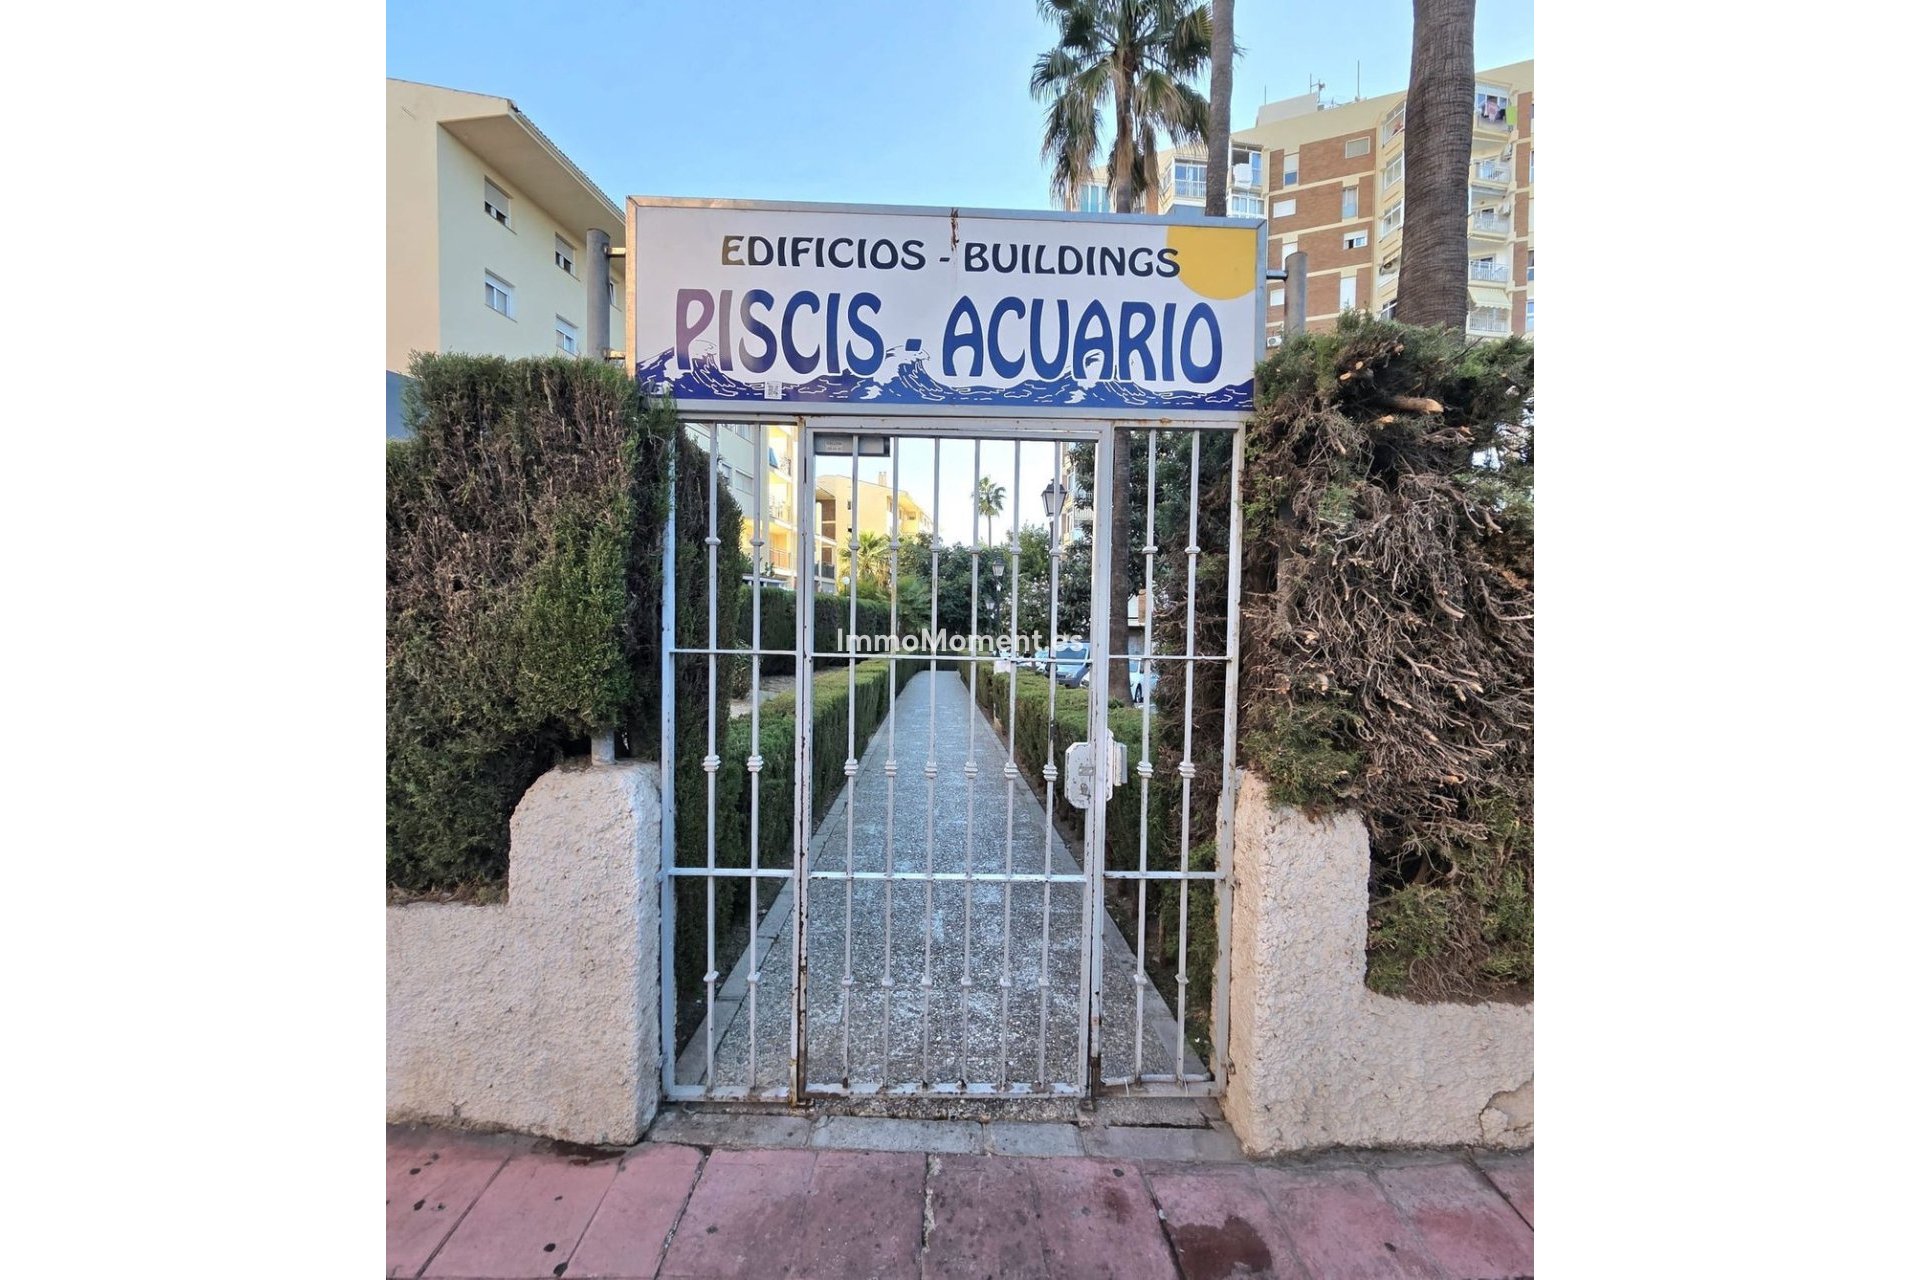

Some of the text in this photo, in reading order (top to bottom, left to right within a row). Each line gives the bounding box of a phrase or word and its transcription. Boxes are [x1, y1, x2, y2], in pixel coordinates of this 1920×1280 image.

[721, 235, 926, 271] EDIFICIOS
[964, 242, 1181, 277] BUILDINGS
[675, 288, 884, 376] PISCIS
[942, 295, 1223, 384] ACUARIO
